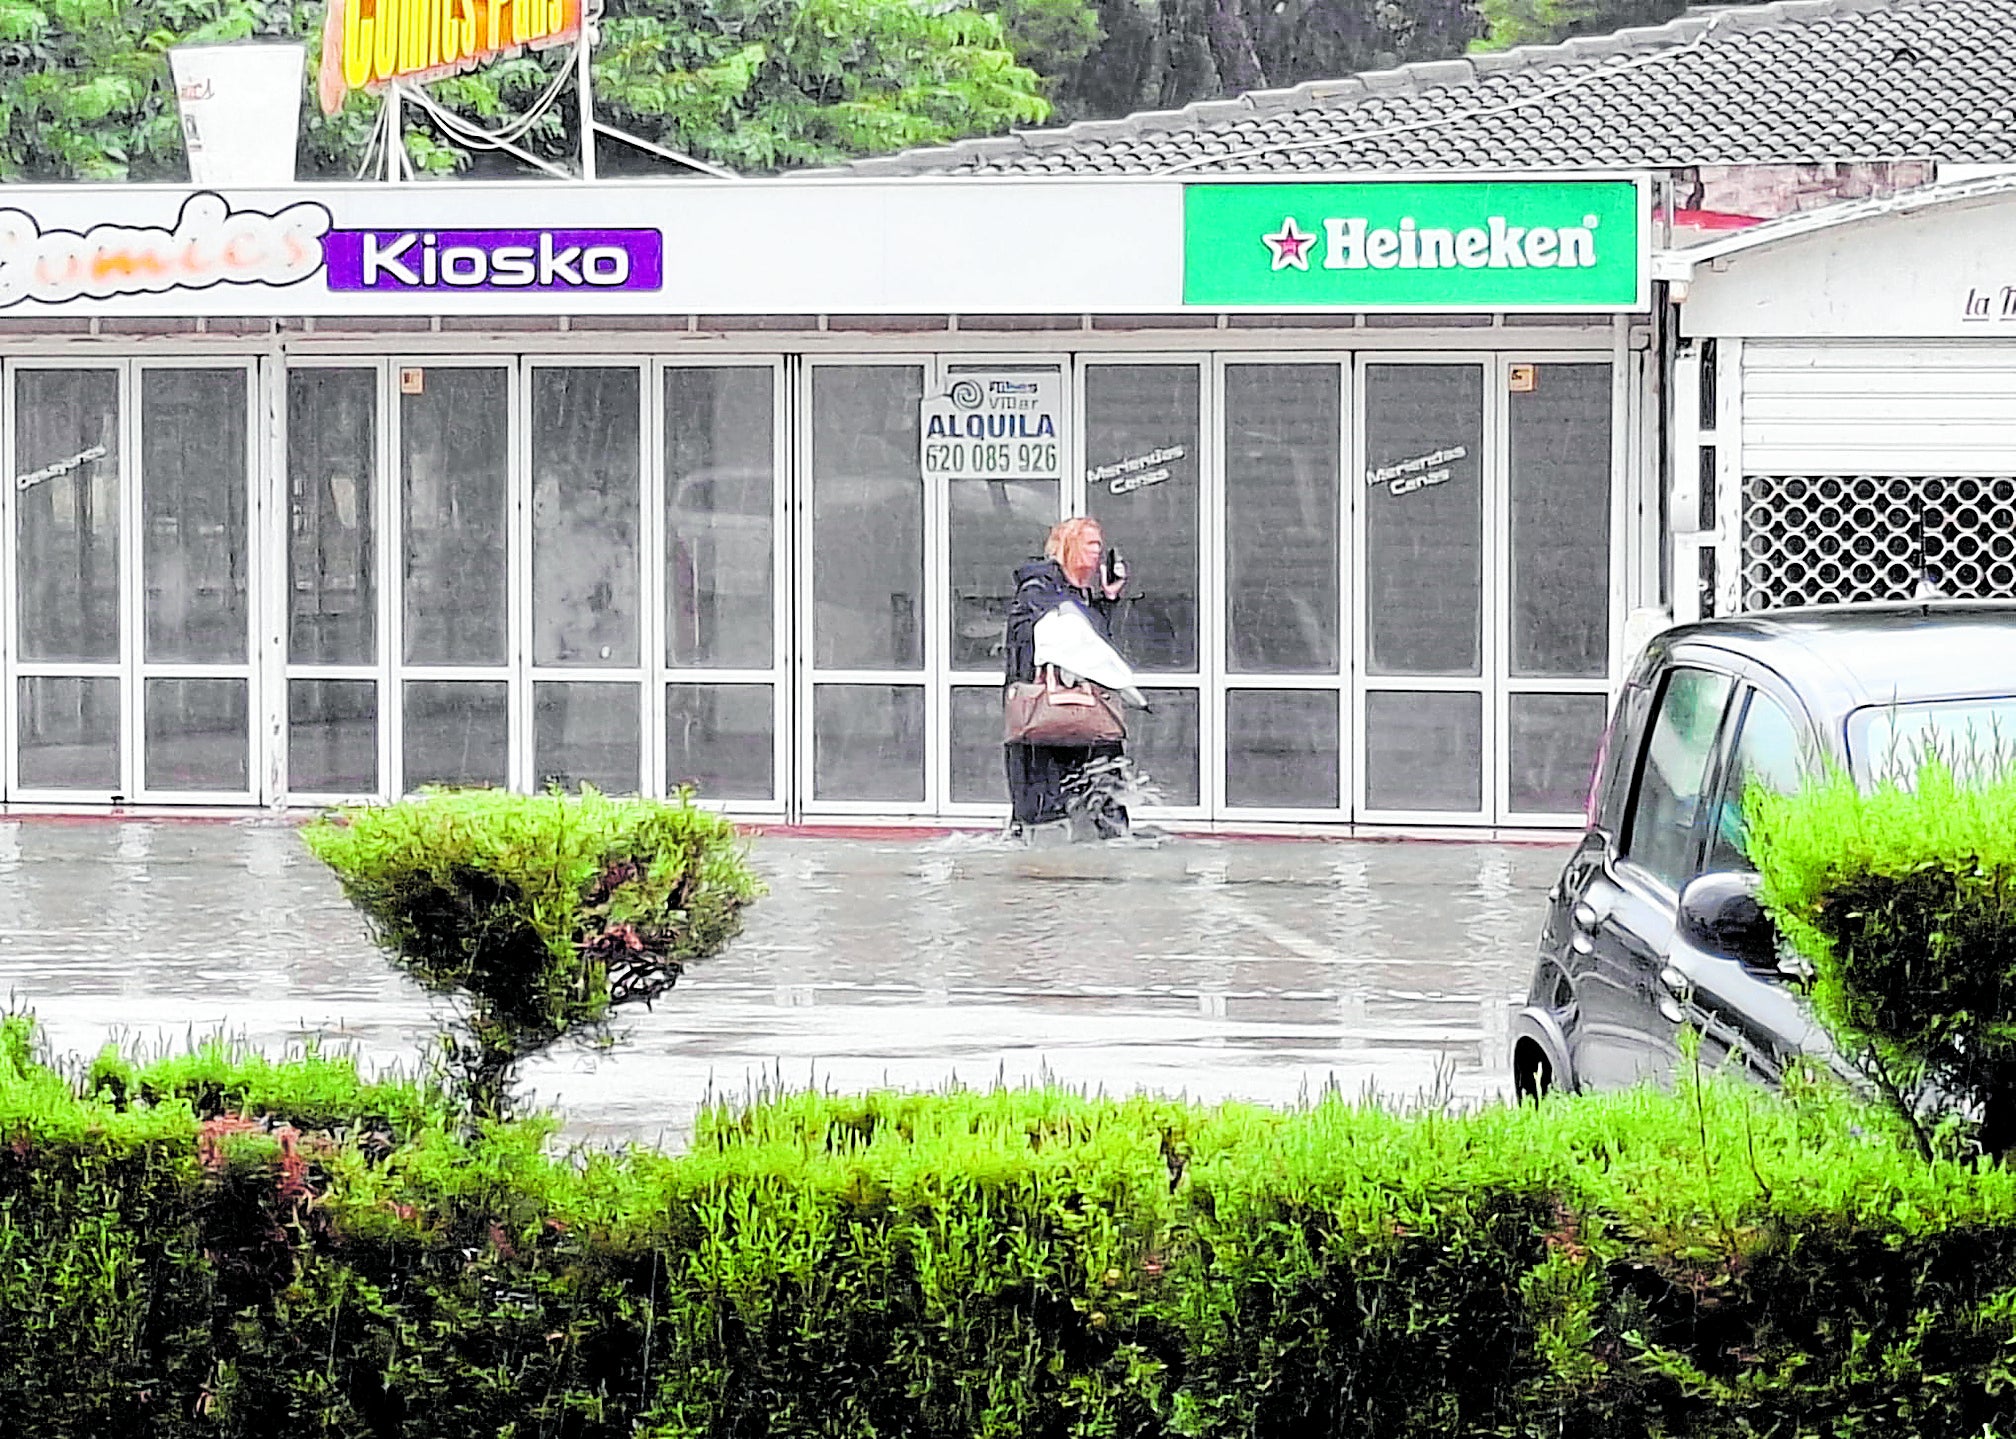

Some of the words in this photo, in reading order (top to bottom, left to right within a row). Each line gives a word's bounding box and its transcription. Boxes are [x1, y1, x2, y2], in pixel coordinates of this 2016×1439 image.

[362, 232, 630, 286] Kiosko
[1322, 215, 1598, 269] Heineken
[926, 414, 1056, 440] ALQUILA
[926, 444, 964, 472] 620
[972, 444, 1010, 472] 085
[1018, 444, 1056, 472] 926
